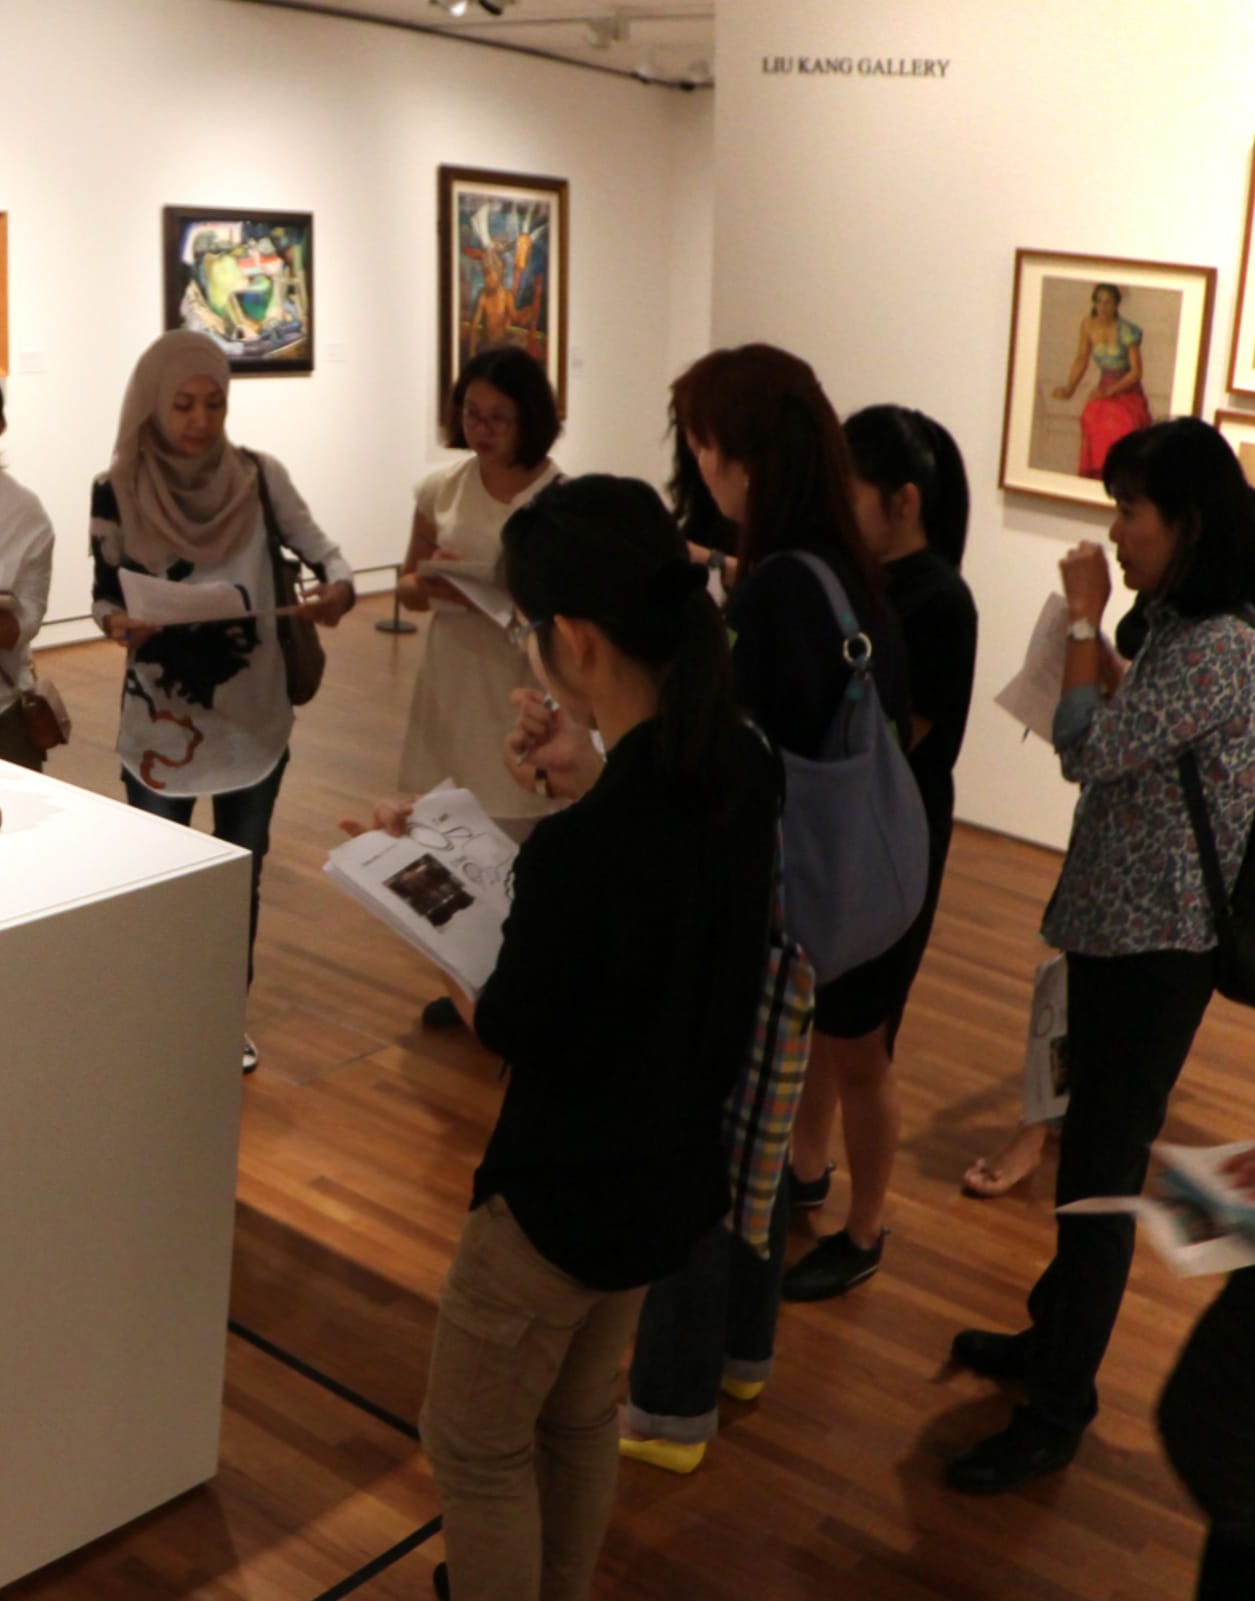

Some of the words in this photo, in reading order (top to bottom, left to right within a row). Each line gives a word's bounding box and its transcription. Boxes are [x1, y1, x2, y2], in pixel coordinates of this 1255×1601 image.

[762, 57, 792, 75] LIU
[798, 57, 853, 76] KANG
[857, 58, 950, 77] GALLERY
